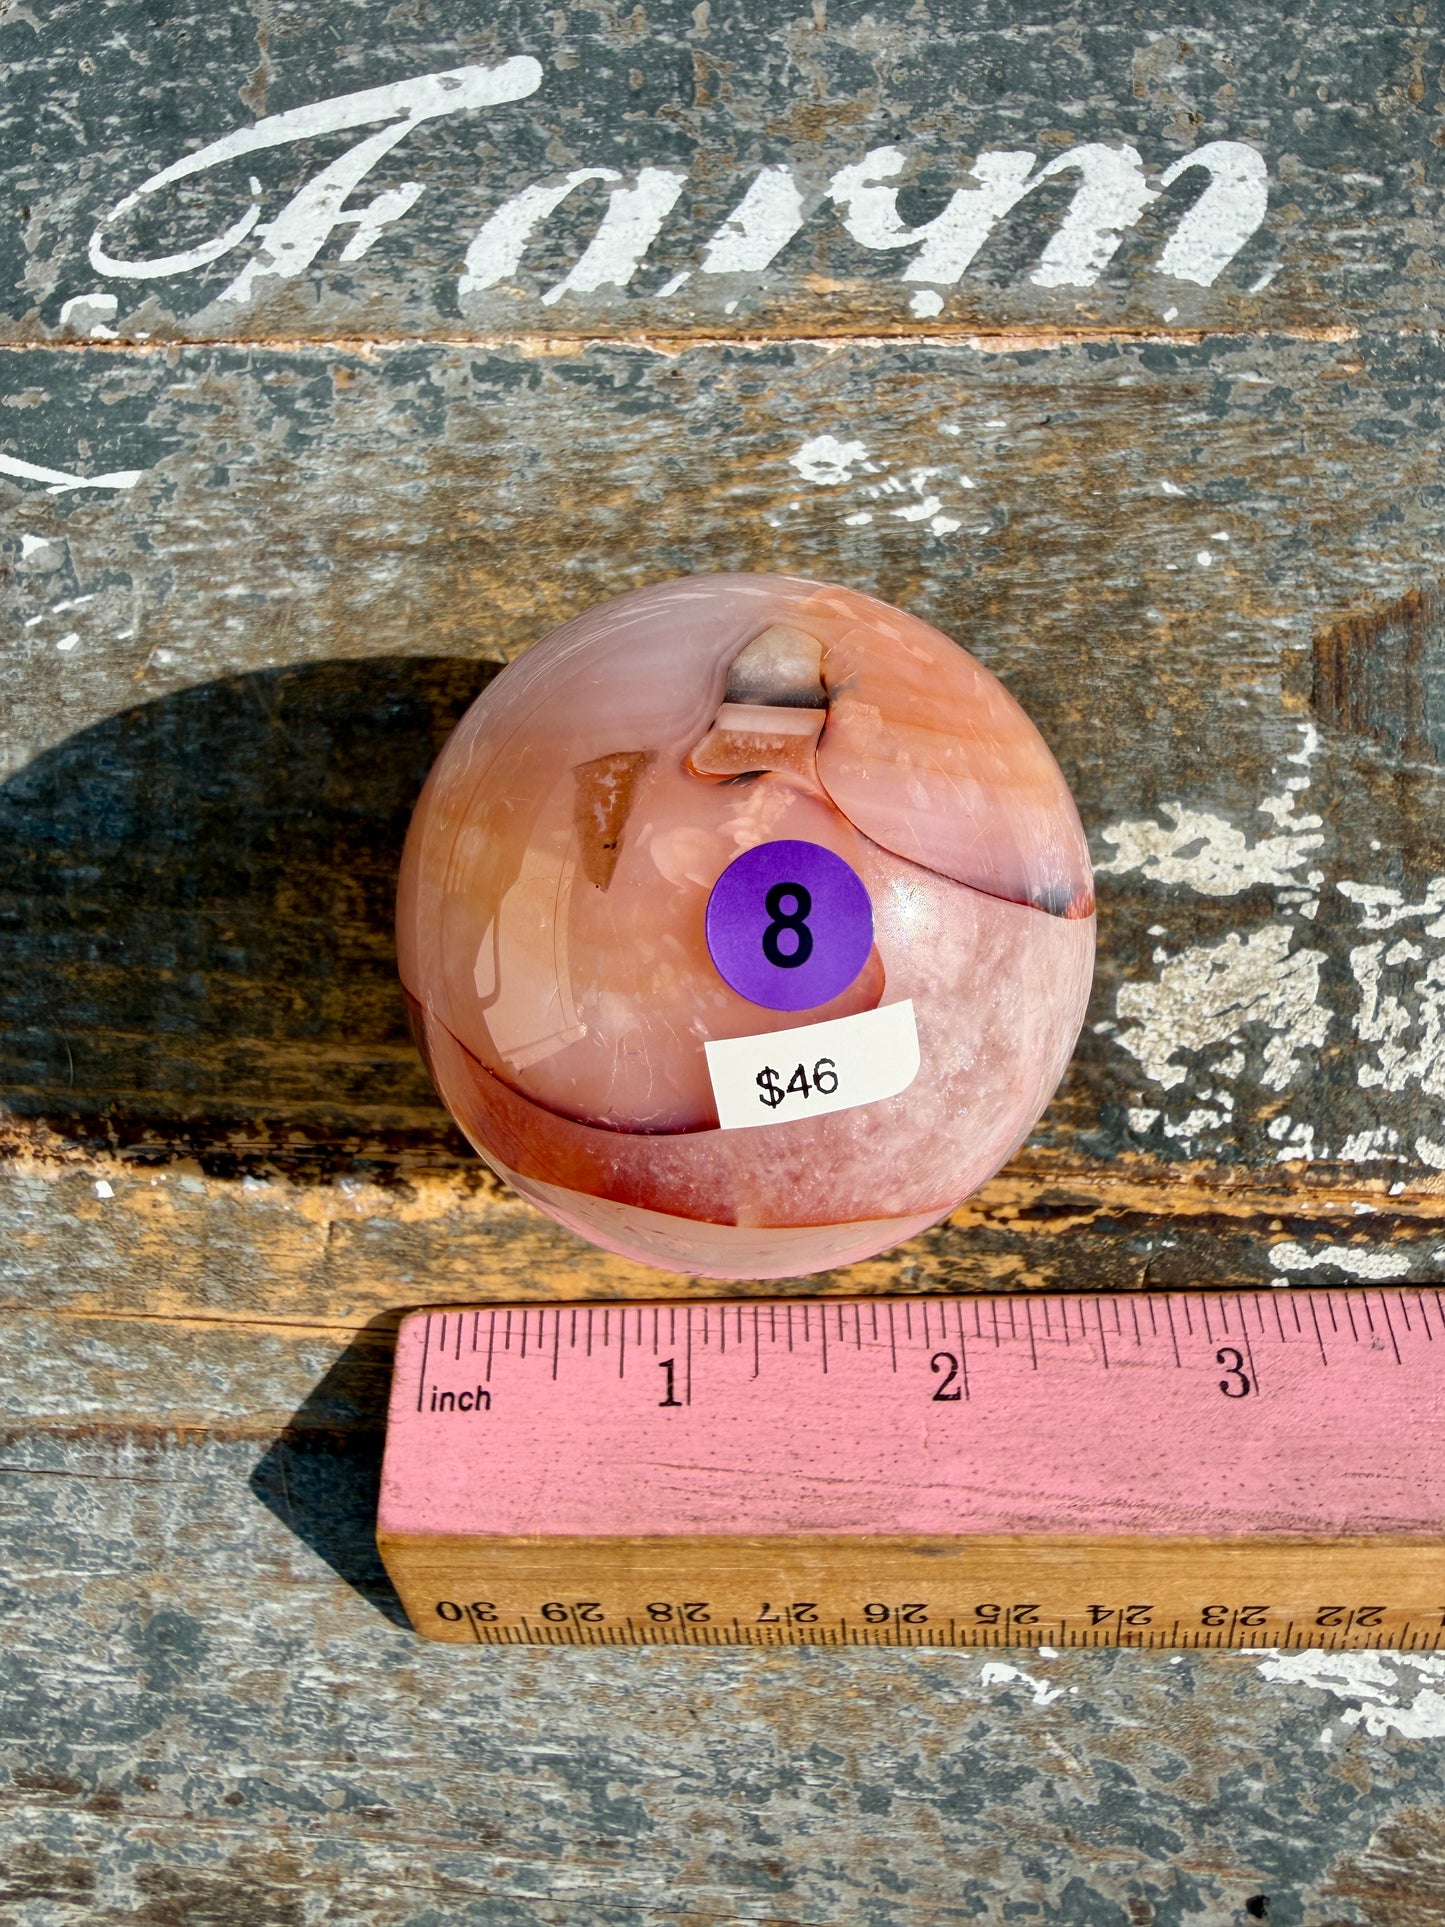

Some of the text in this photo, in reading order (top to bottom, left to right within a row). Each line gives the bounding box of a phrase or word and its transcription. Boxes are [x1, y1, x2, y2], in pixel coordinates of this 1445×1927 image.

[762, 882, 814, 968] 8
[755, 1058, 839, 1109] $46
[430, 1347, 1251, 1412] inch 1 2 3
[436, 1602, 1386, 1627] 22 23 24 25 26 27 28 29 30
